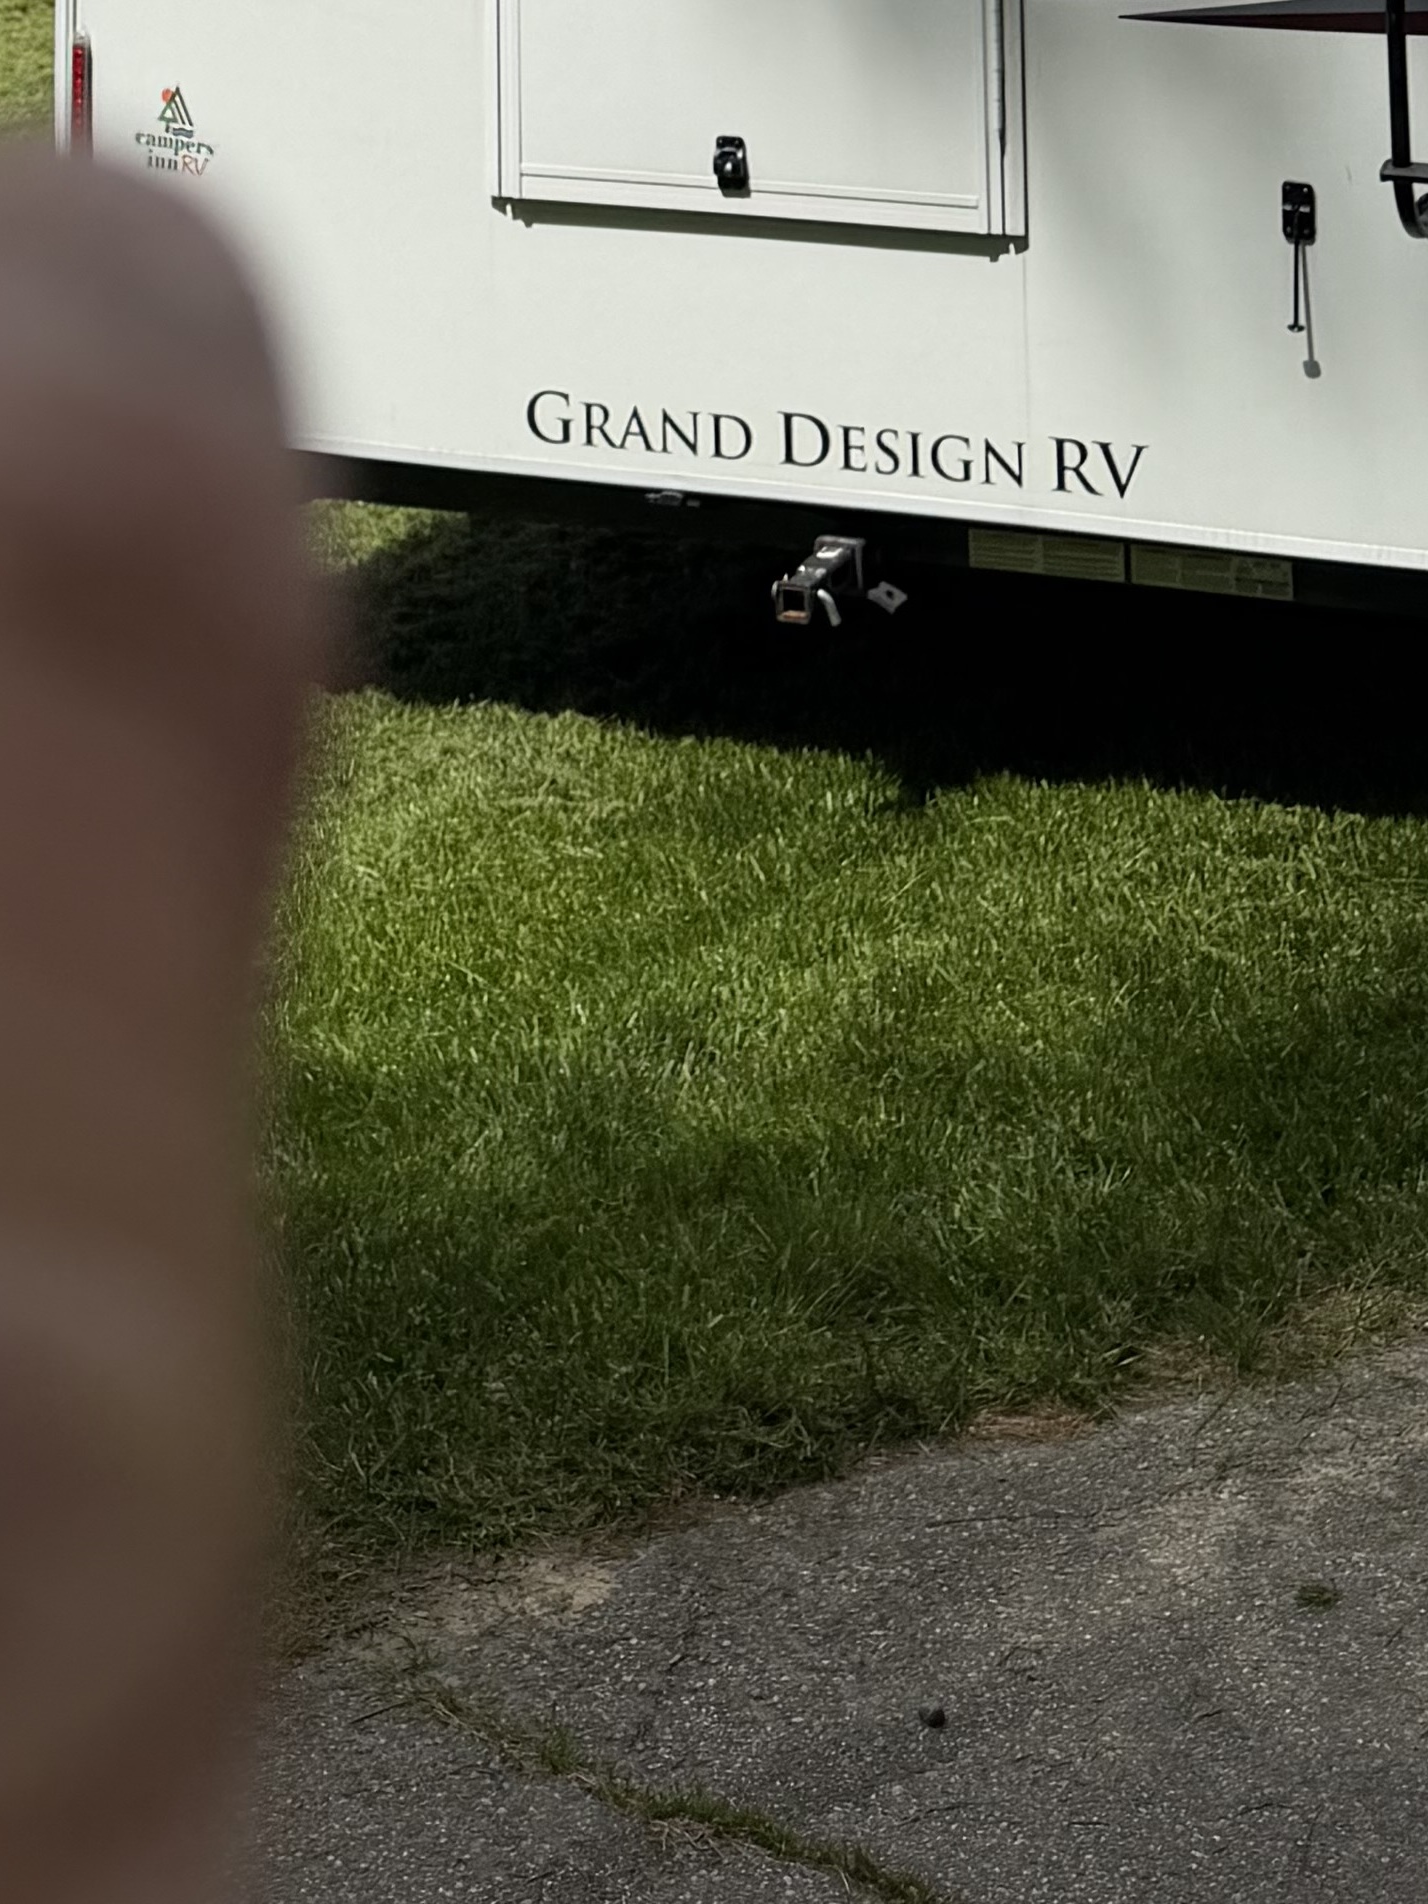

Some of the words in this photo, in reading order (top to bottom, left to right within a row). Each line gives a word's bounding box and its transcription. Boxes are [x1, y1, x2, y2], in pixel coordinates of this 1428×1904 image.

[526, 390, 753, 461] GRAND
[776, 410, 1026, 488] DESIGN
[1050, 436, 1149, 500] RV
